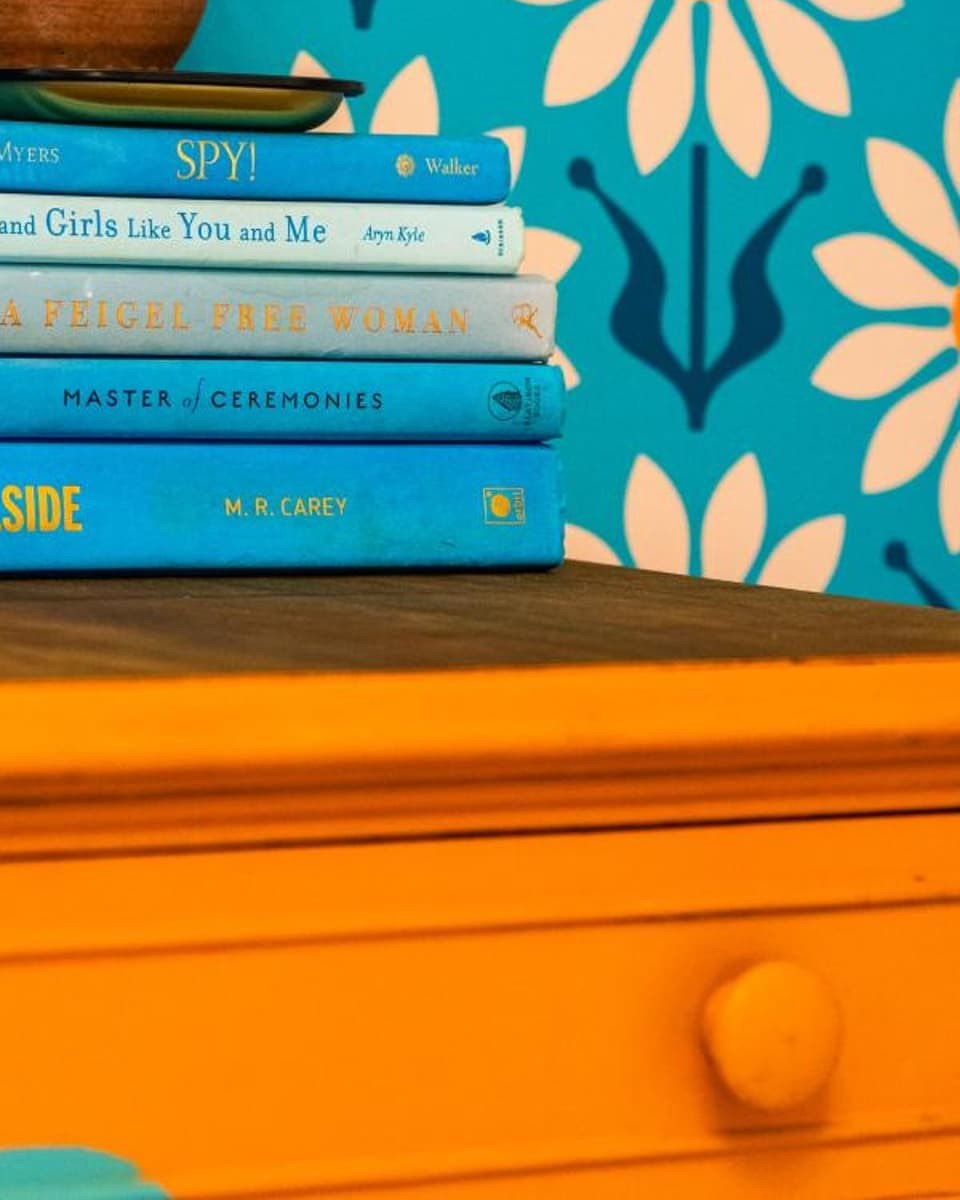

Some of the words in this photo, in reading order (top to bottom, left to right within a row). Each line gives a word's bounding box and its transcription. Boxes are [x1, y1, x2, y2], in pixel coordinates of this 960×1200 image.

[176, 138, 257, 181] SPY!
[425, 156, 479, 176] Walker
[46, 207, 118, 238] Girls
[127, 218, 171, 240] Like
[177, 211, 231, 241] You
[240, 222, 275, 242] and
[285, 215, 327, 244] Me
[362, 225, 393, 246] Aryn
[397, 226, 426, 246] Kyle
[43, 298, 191, 330] FEIGEL
[212, 303, 308, 333] FREE
[329, 305, 470, 335] WOMAN
[63, 389, 172, 408] MASTER
[182, 377, 206, 413] of
[211, 390, 383, 411] CEREMONIES
[224, 497, 247, 517] M.
[255, 497, 274, 517] R.
[281, 497, 347, 518] CAREY
